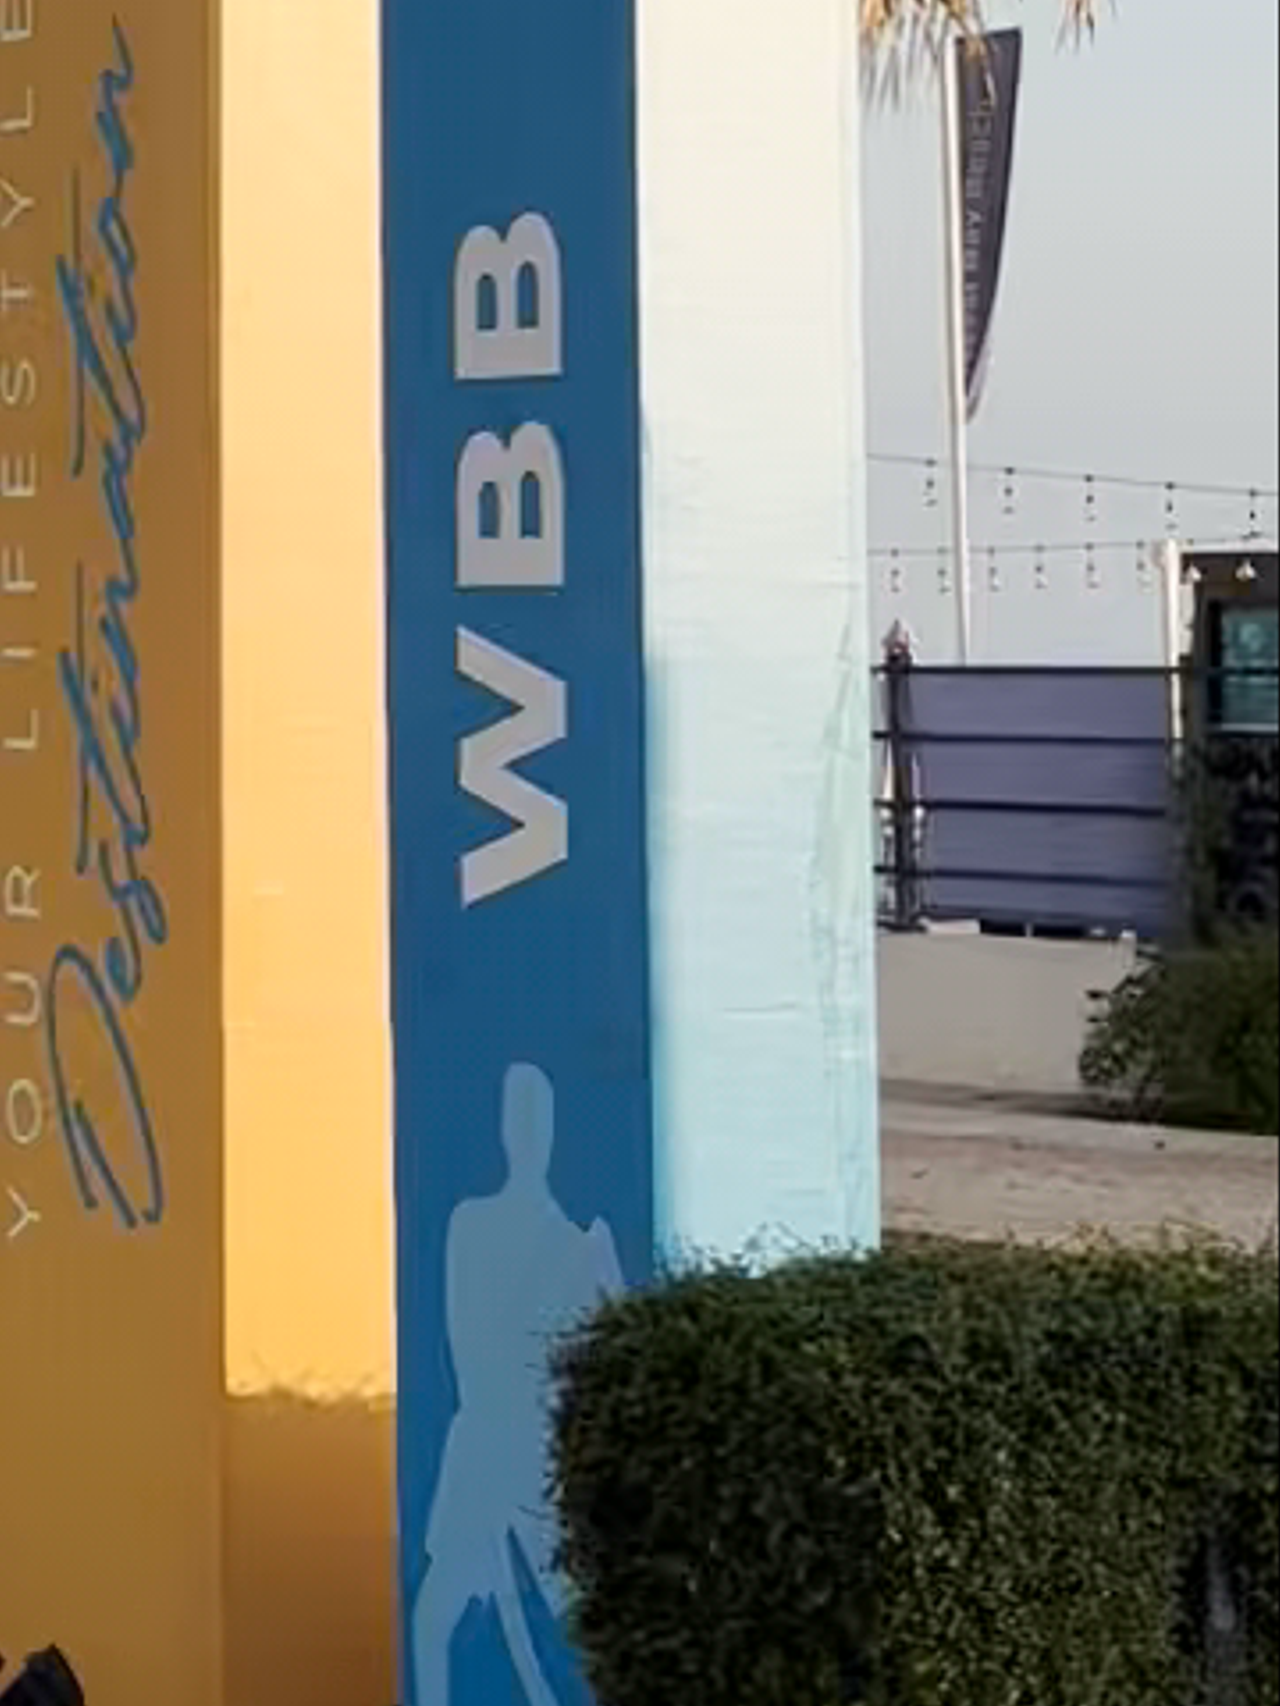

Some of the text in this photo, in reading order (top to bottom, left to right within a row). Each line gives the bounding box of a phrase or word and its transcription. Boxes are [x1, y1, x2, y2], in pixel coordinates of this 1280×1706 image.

[49, 16, 168, 1228] Destination
[454, 209, 569, 908] WBB
[5, 865, 42, 1240] YOUR
